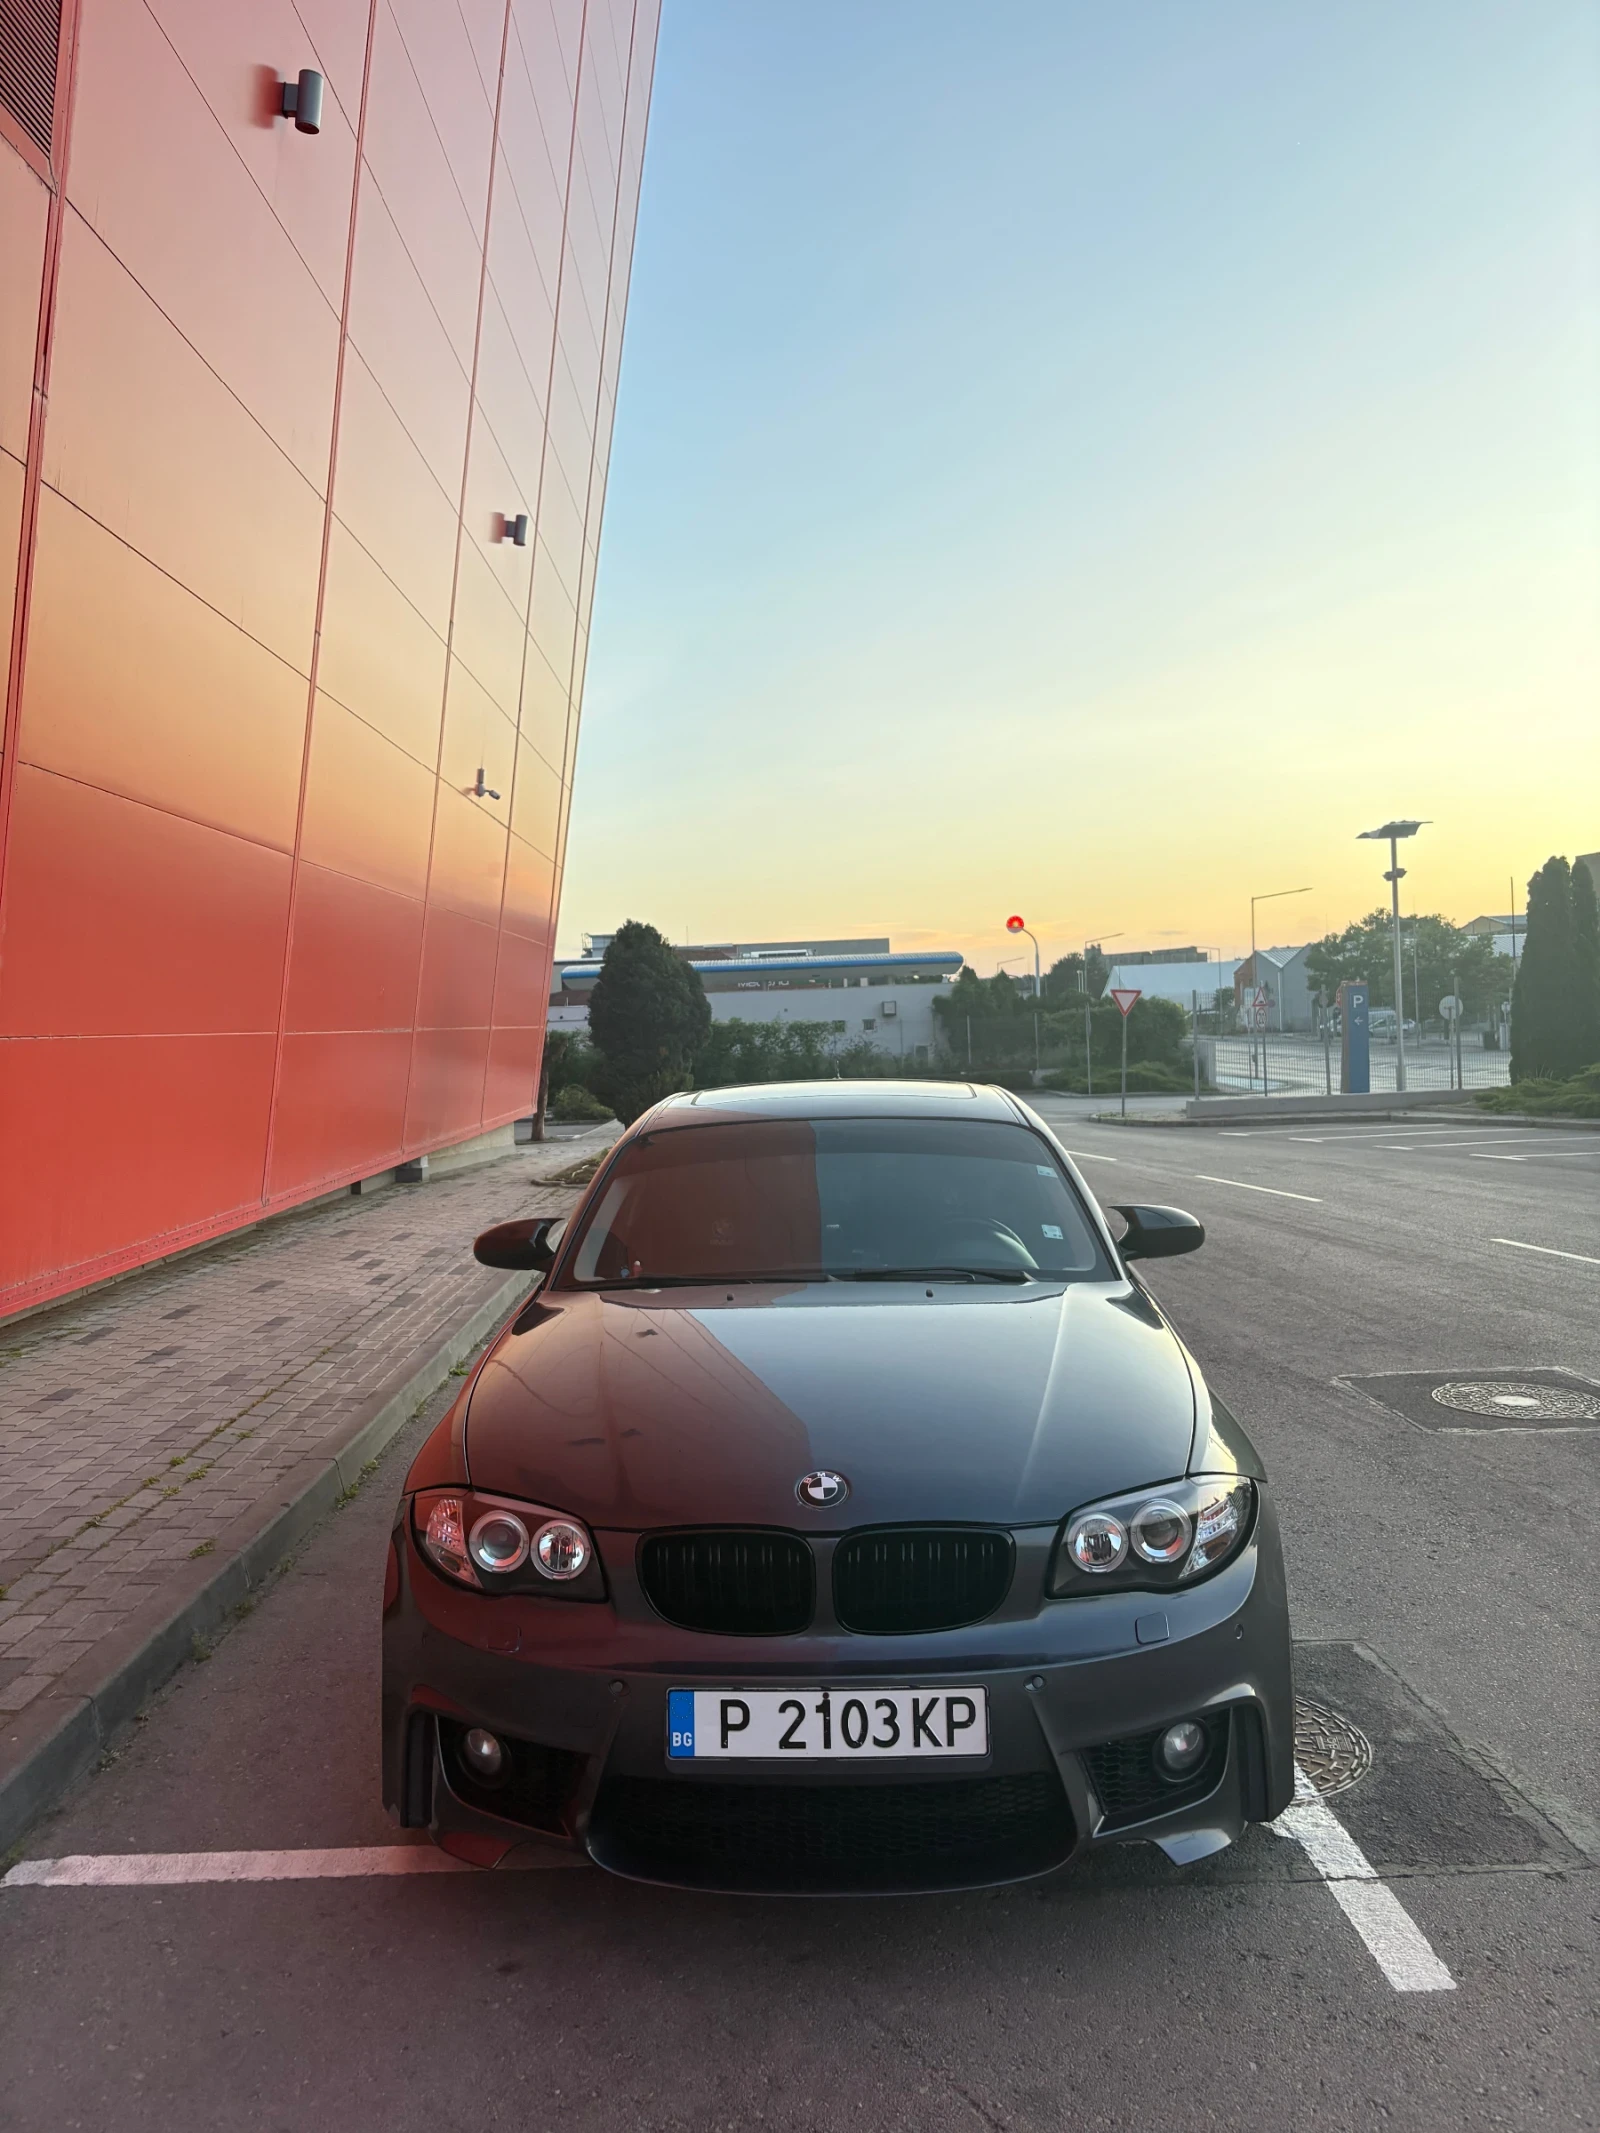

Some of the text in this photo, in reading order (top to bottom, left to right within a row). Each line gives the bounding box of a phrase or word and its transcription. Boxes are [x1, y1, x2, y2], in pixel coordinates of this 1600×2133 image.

[1353, 995, 1364, 1008] P
[803, 1471, 842, 1484] BMW
[672, 1731, 693, 1747] BG
